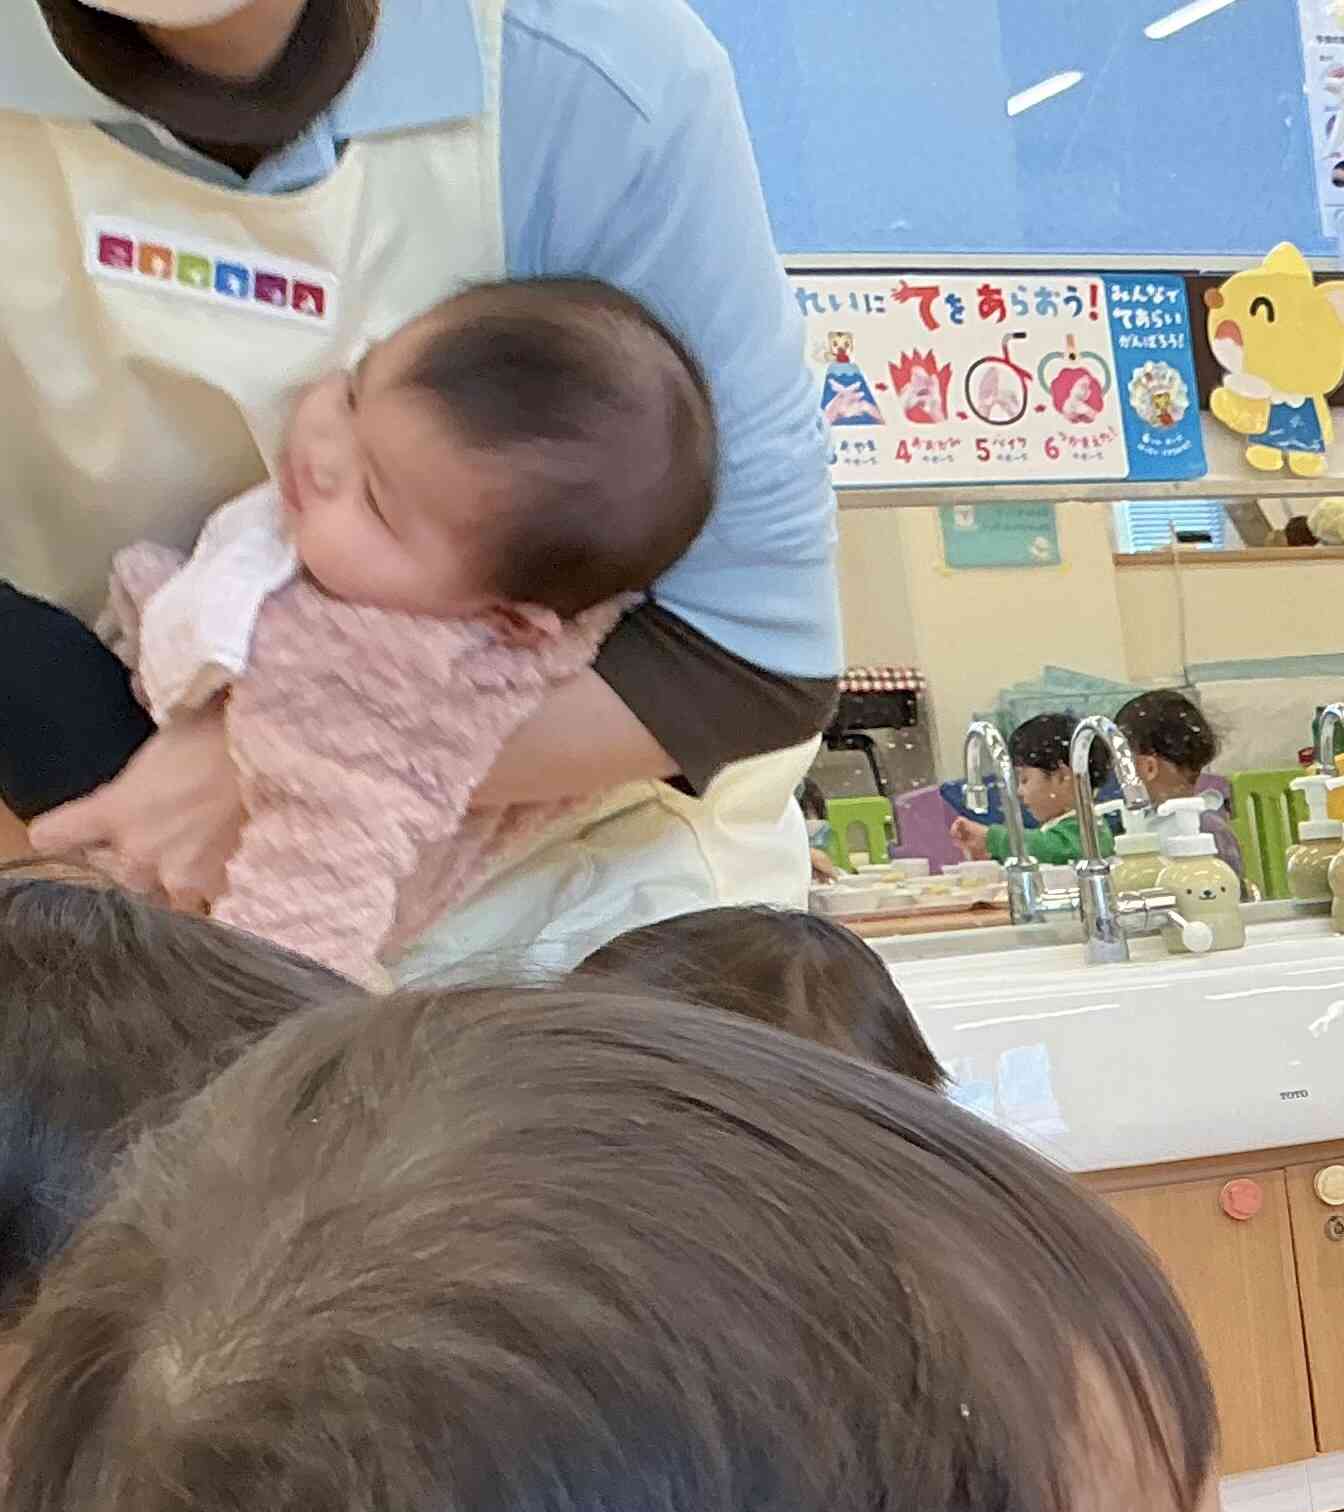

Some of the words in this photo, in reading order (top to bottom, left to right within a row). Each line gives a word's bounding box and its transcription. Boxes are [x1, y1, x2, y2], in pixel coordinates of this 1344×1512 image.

[1112, 307, 1182, 329] てあらい
[896, 440, 912, 463] 4
[976, 438, 991, 462] 5
[1044, 436, 1060, 460] 6
[1280, 1090, 1308, 1100] TOTO
